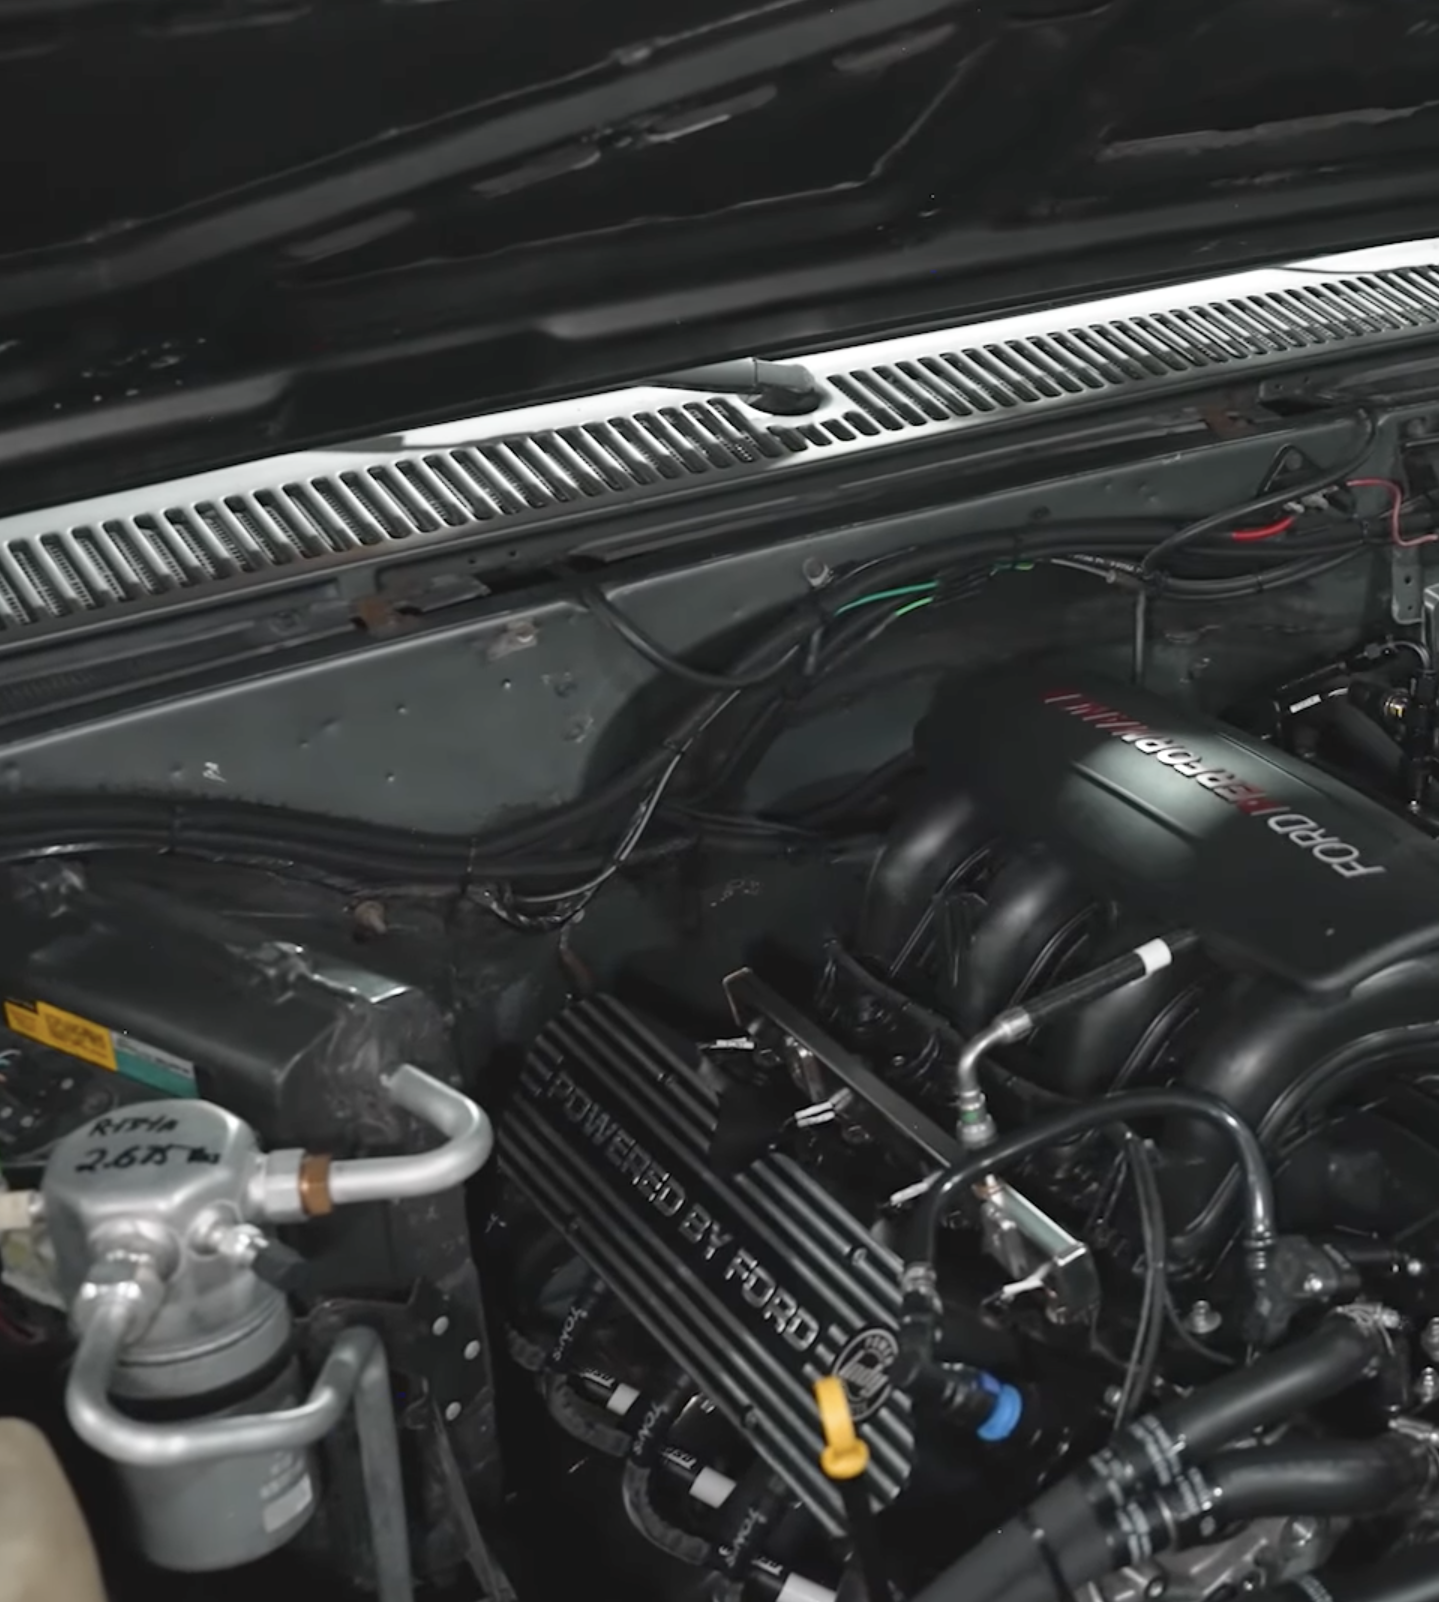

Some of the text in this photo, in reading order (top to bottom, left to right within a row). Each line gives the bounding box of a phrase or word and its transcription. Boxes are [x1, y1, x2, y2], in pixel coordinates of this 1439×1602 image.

[1043, 690, 1387, 878] FORD PERFORMAN
[549, 1070, 820, 1351] POWERED BY FORD
